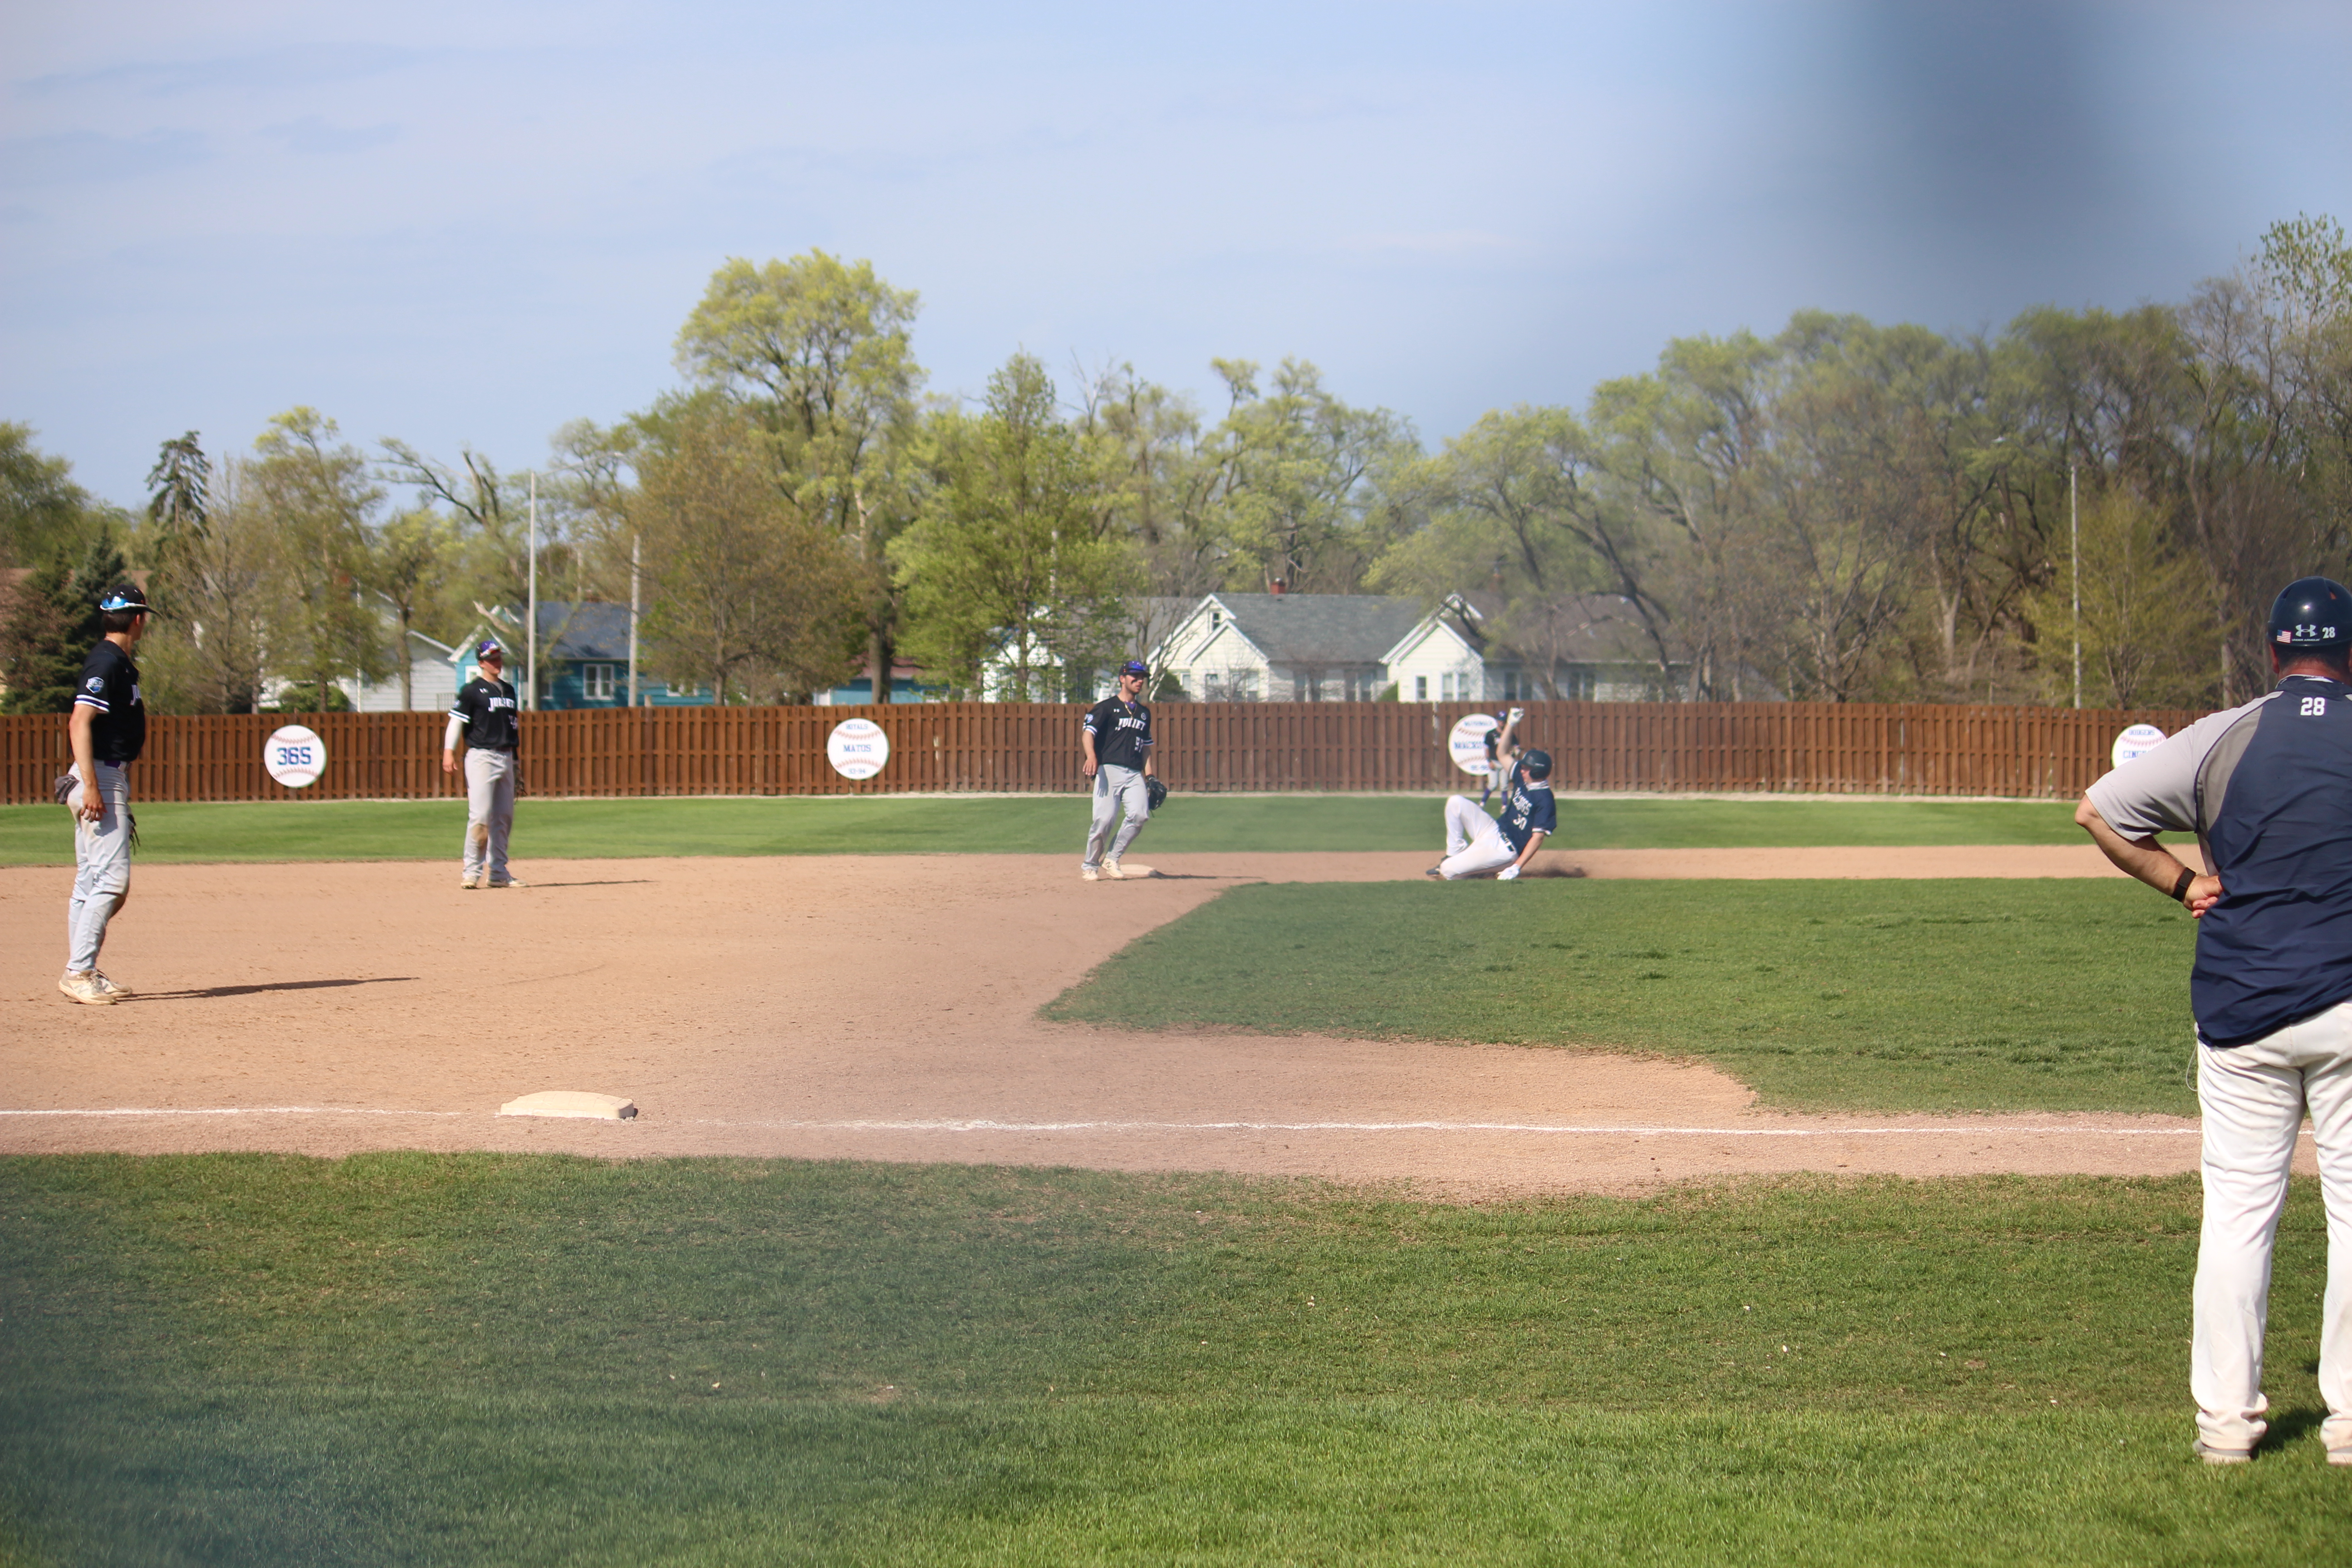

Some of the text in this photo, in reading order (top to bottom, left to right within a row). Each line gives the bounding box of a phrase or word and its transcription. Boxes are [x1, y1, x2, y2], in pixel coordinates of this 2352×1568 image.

[2322, 627, 2335, 639] 28
[2300, 697, 2325, 716] 28
[1115, 718, 1146, 731] JOLIET
[277, 747, 311, 765] 365
